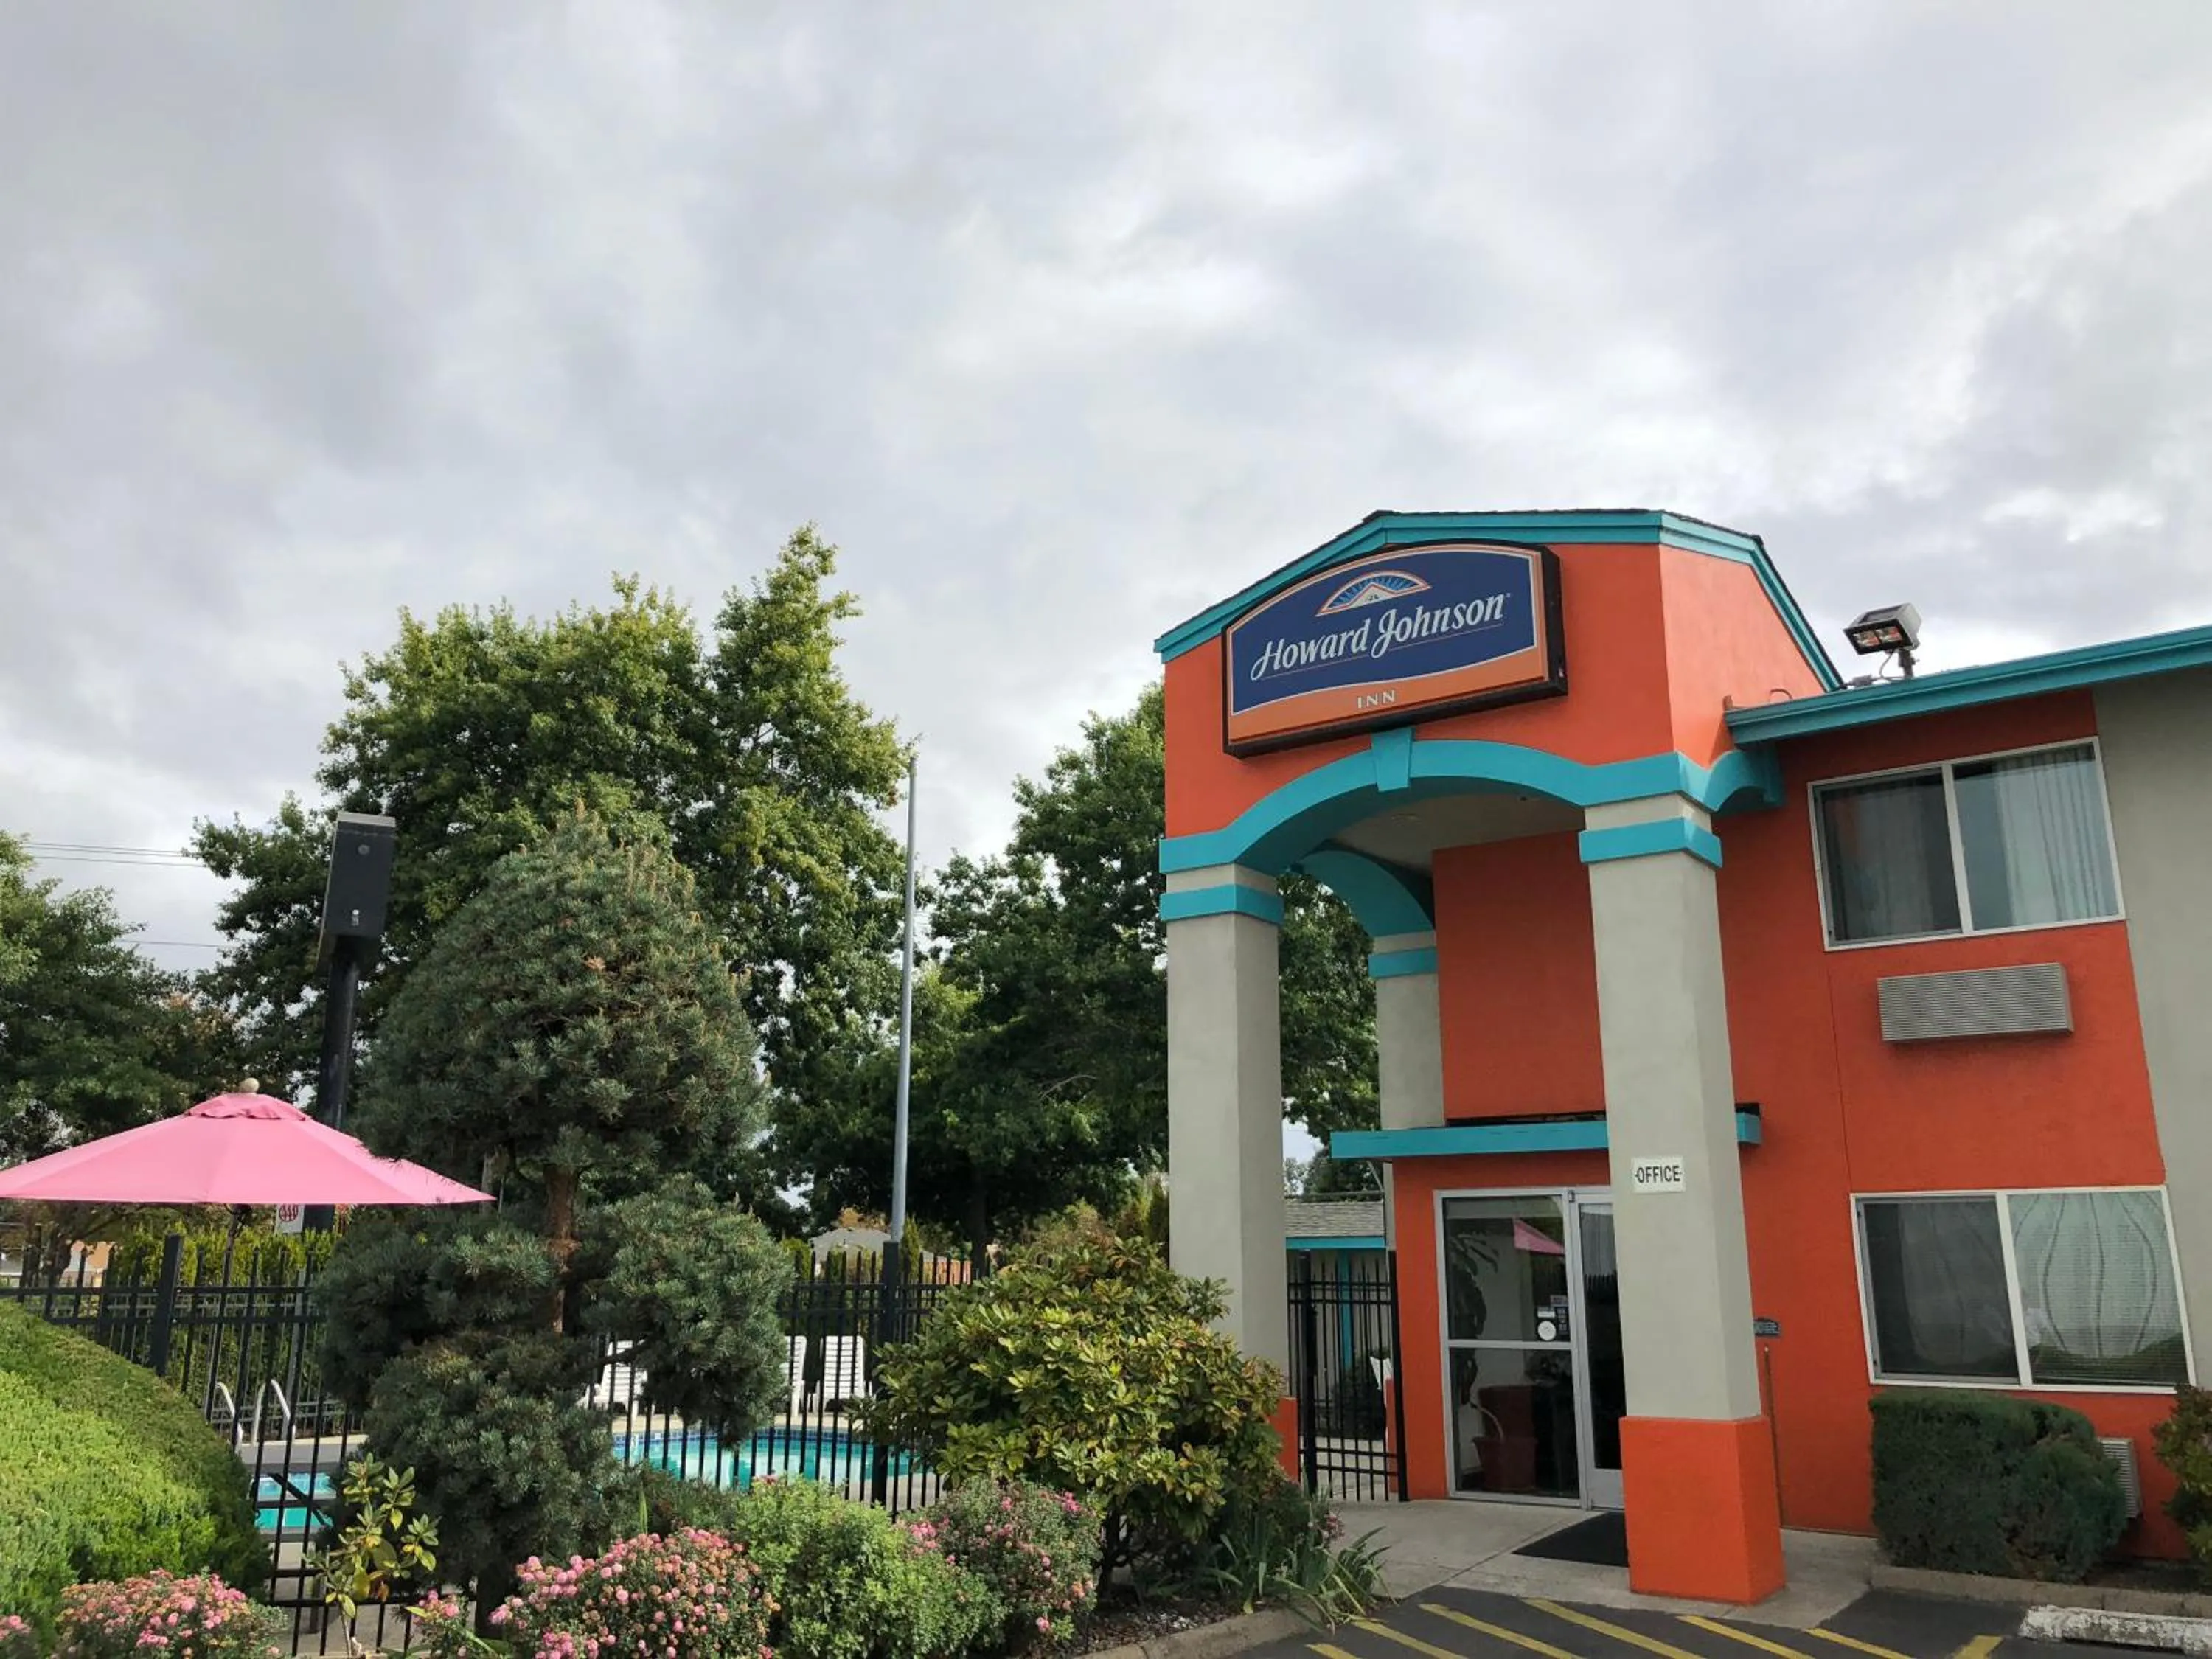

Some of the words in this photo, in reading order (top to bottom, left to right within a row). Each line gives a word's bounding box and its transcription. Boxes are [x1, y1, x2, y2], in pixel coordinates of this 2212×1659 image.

[1250, 617, 1371, 681] Howard
[1371, 593, 1505, 658] Johnson
[1357, 689, 1395, 709] INN
[1637, 1165, 1681, 1183] OFFICE
